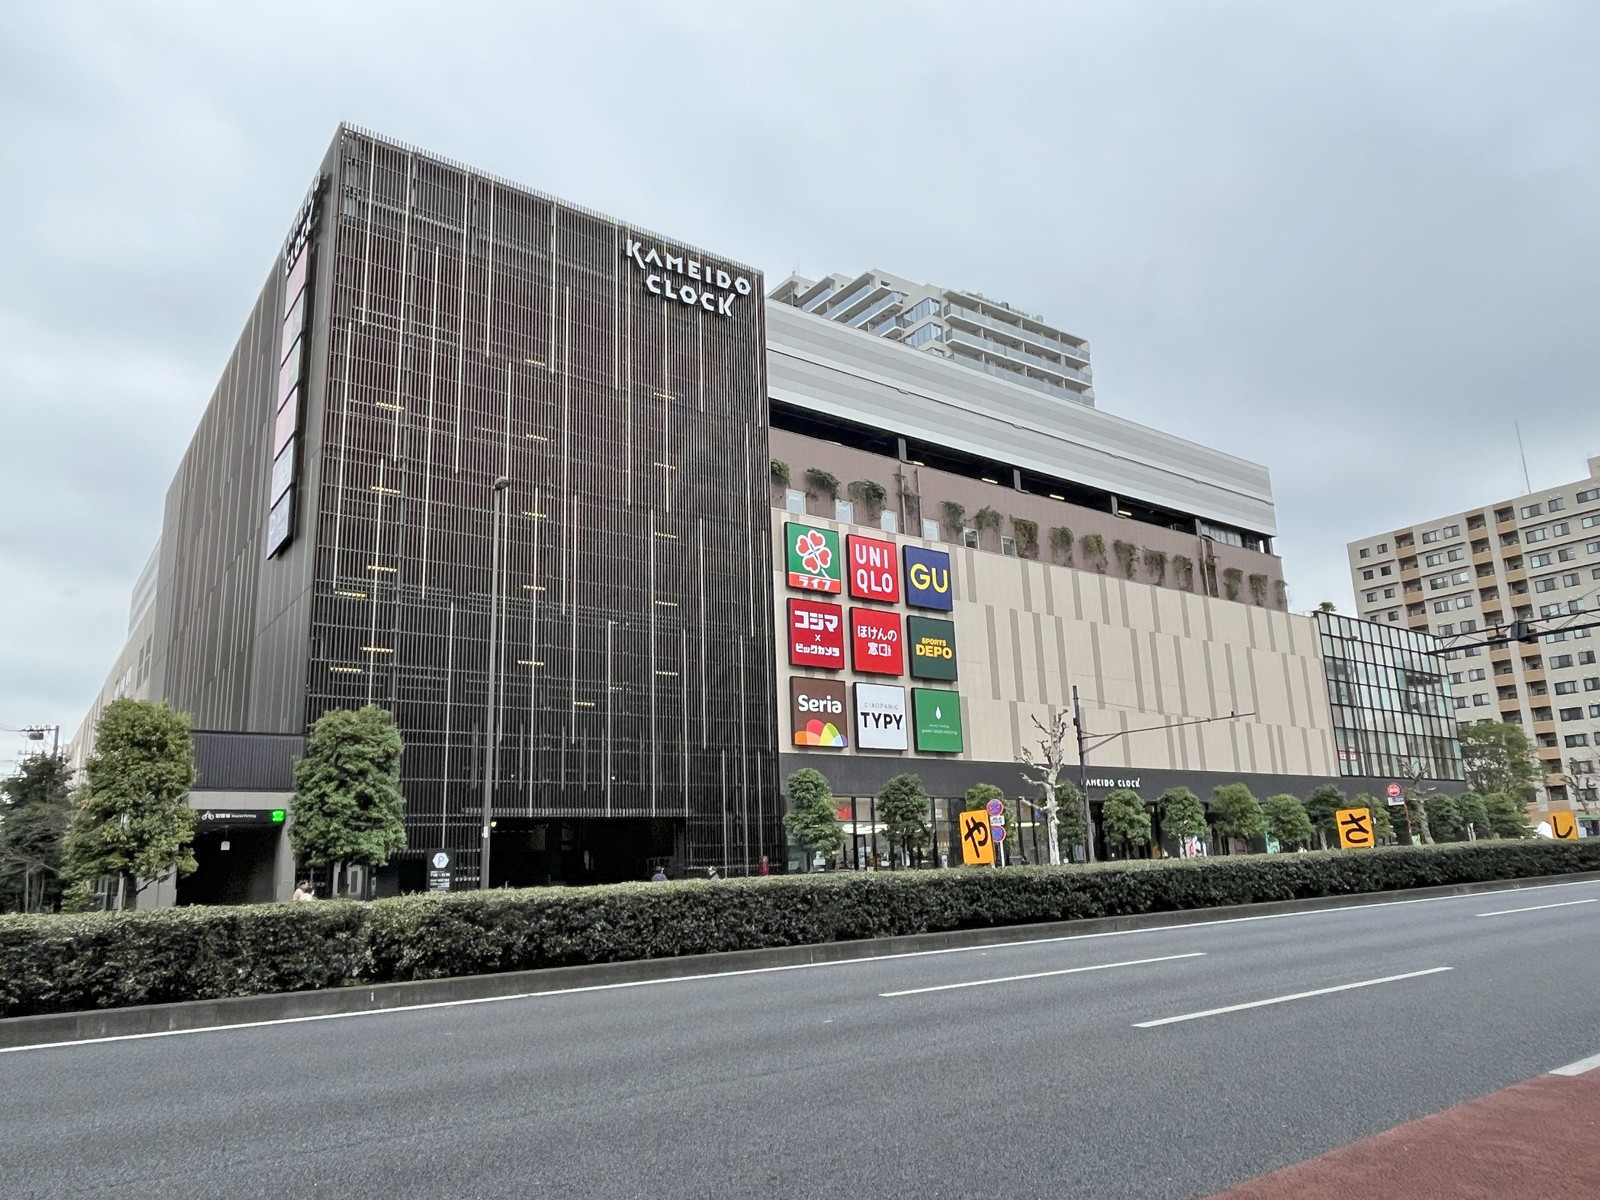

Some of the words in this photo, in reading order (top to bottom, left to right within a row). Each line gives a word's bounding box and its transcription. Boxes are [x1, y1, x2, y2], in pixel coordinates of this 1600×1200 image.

[626, 239, 751, 295] KAMEIDO
[646, 274, 736, 317] CLOCK
[855, 543, 889, 569] UNI
[798, 575, 832, 591] ライフ
[856, 569, 893, 593] QLO
[910, 563, 949, 593] GU
[794, 610, 838, 632] コジマ
[857, 625, 897, 642] ほけんの
[921, 637, 947, 647] SPORTS
[915, 644, 953, 659] DEPO
[798, 694, 843, 714] Seria
[860, 712, 903, 730] TYPY
[1117, 777, 1140, 788] CLOCK
[964, 816, 988, 858] や
[1341, 813, 1369, 844] さ
[1552, 815, 1573, 838] し
